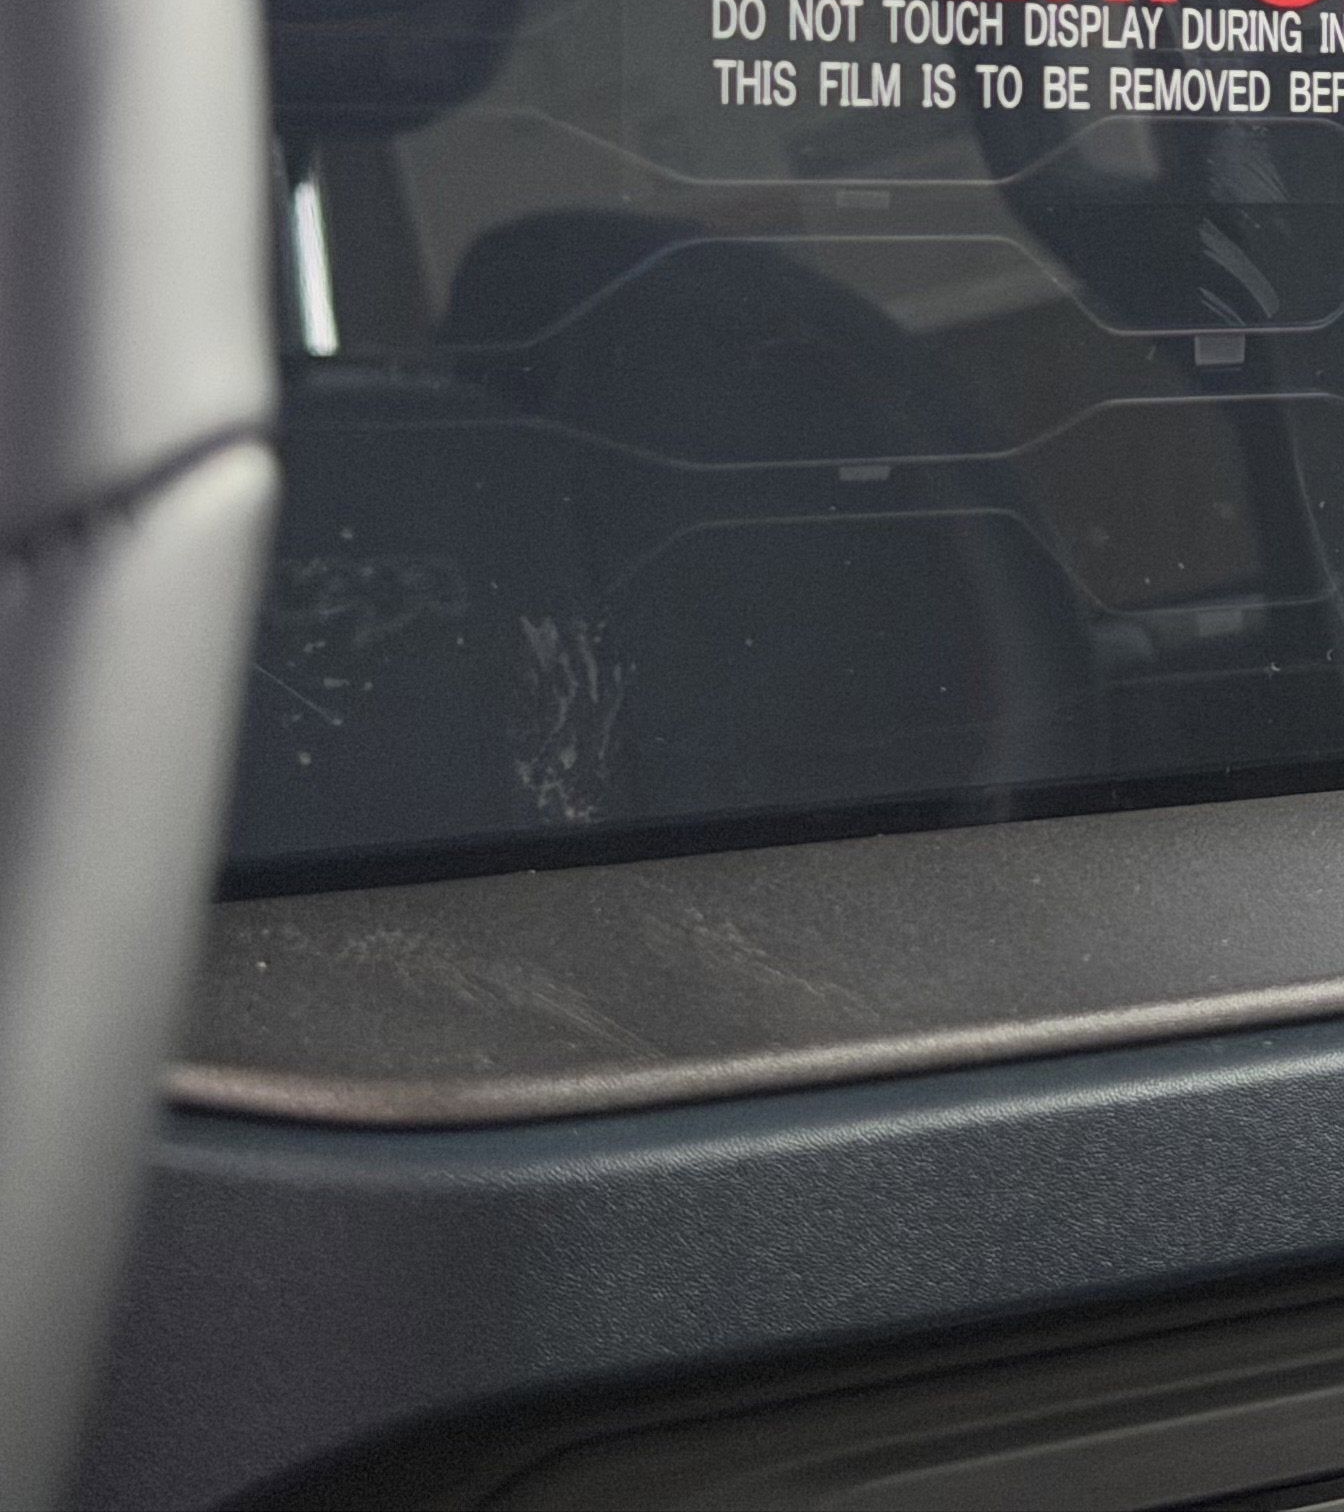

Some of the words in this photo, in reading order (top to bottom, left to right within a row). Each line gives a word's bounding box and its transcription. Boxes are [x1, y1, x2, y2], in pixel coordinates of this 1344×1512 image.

[1025, 0, 1163, 51] DISPLAY
[1183, 6, 1302, 54] DURING
[713, 59, 797, 107] THIS
[819, 61, 901, 108] FILM
[922, 63, 956, 109] IS
[976, 64, 1023, 110] TO
[1044, 66, 1091, 111] BE
[1109, 68, 1270, 113] REMOVED
